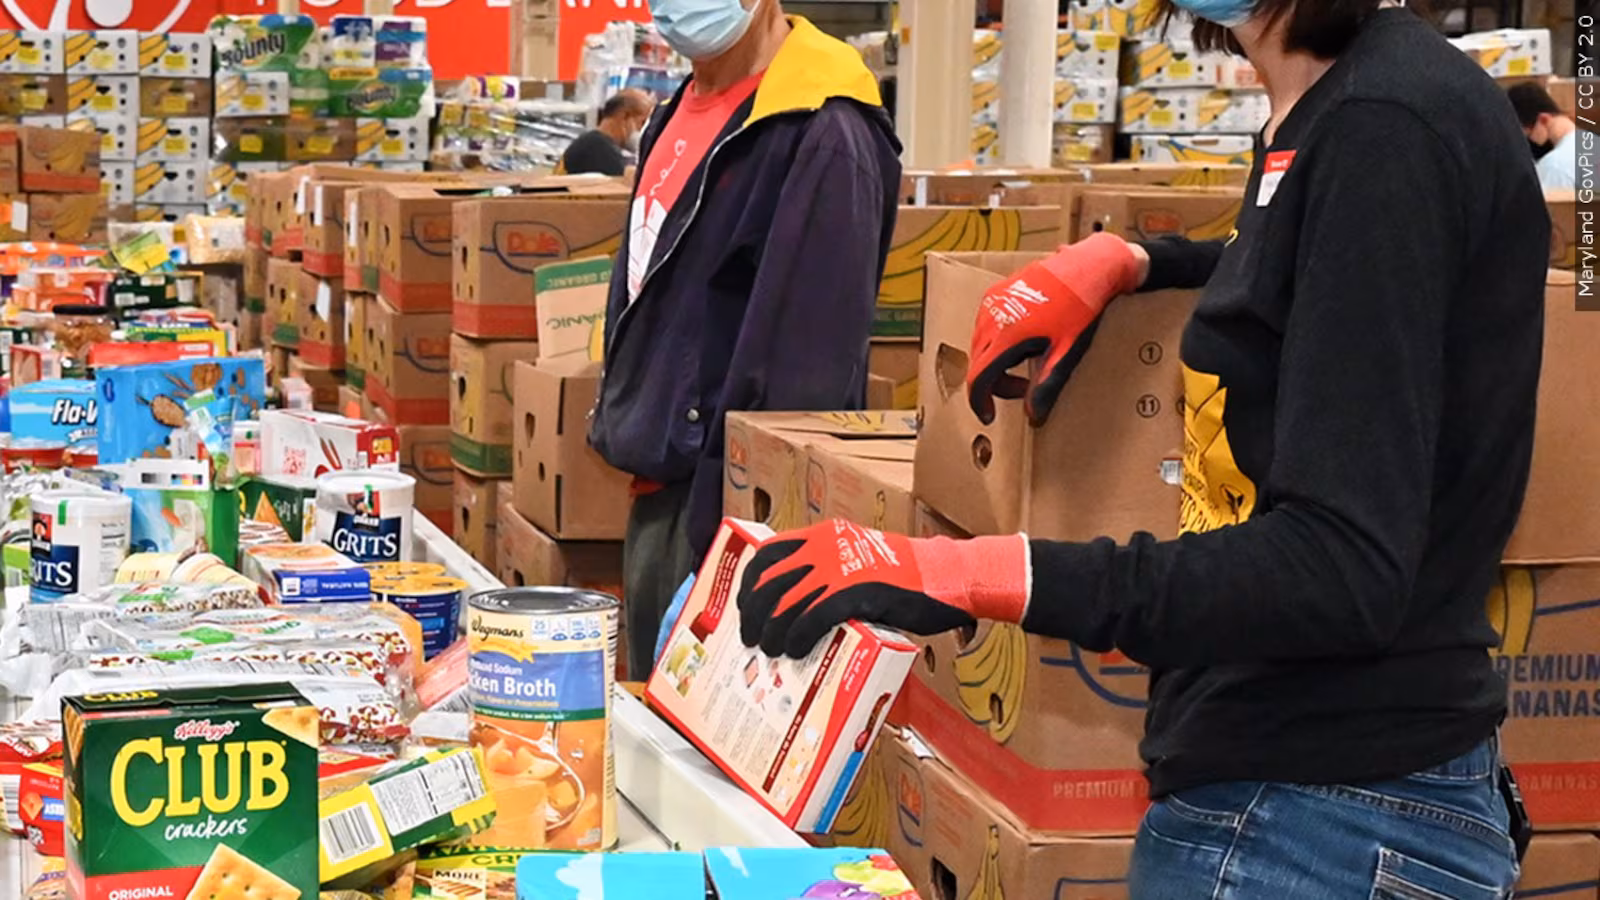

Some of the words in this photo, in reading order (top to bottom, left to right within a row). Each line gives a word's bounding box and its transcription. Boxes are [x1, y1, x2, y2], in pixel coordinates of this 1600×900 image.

[506, 231, 561, 252] Dole
[333, 528, 397, 557] GRITS
[471, 615, 524, 642] Wegmans
[494, 661, 523, 675] Sodium
[83, 690, 159, 702] CLUB
[503, 676, 557, 697] Broth
[174, 718, 235, 742] Kellogg's
[110, 736, 290, 827] CLUB
[1053, 780, 1135, 799] PREMIUM
[164, 814, 248, 841] crackers
[108, 886, 174, 900] ORIGINAL
